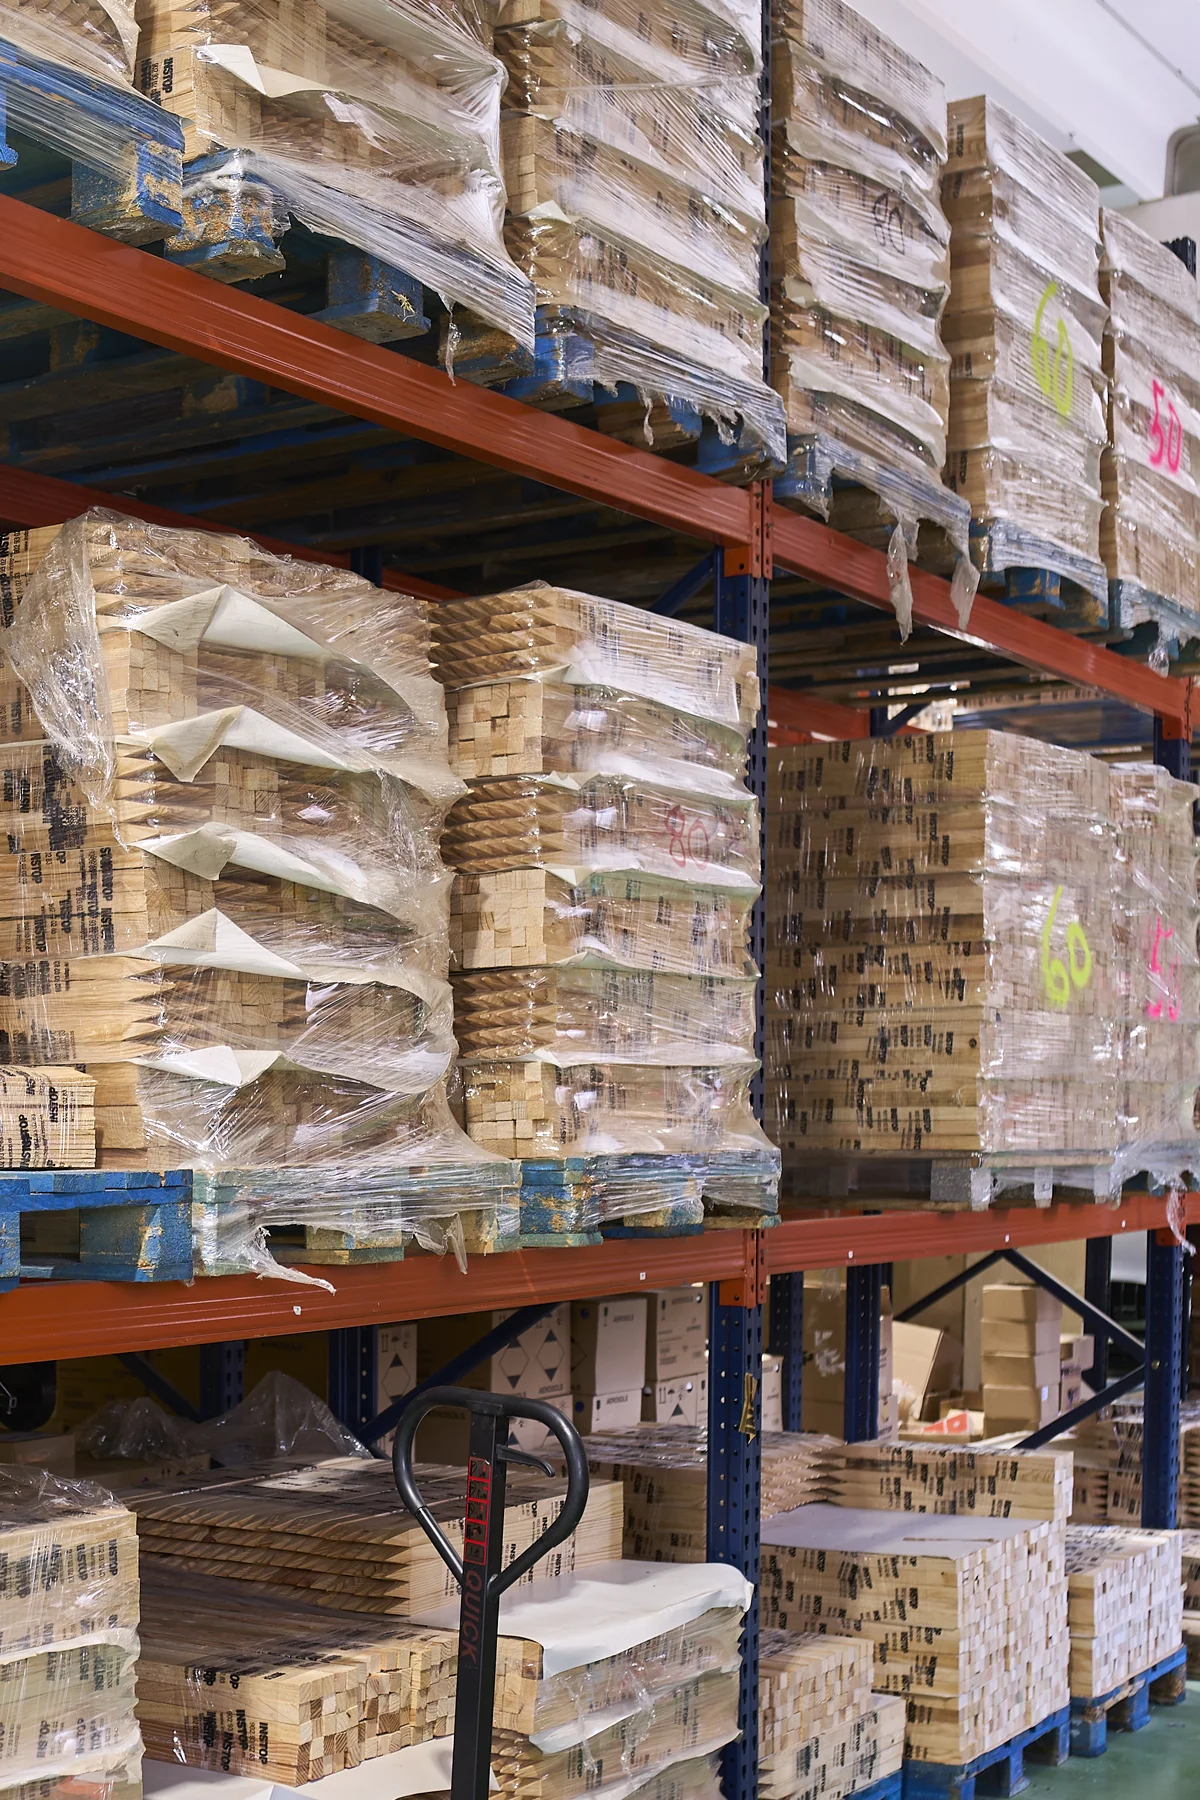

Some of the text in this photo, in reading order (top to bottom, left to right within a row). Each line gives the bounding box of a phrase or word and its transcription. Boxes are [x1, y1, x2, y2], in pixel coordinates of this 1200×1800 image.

[871, 192, 905, 255] 80
[1030, 281, 1073, 423] 60
[1150, 379, 1182, 474] 50
[926, 734, 934, 764] INSTOP
[946, 751, 954, 781] INSTOP
[664, 804, 710, 872] 80
[941, 835, 950, 866] INSTOP
[927, 880, 935, 909] INSTOP
[34, 919, 46, 952] INSTOP
[941, 907, 950, 941] INSTOP
[1042, 884, 1092, 1005] 60
[945, 1032, 954, 1055] INSTOP
[49, 1086, 58, 1123] INSTOP
[890, 1108, 899, 1132] INSTOP
[923, 1109, 931, 1134] INSTOP
[613, 1314, 634, 1322] AEROSOLS
[538, 1384, 564, 1394] AEROSOLS
[606, 1395, 629, 1404] AEROSOLS
[108, 1538, 118, 1576] INSTOP
[460, 1570, 483, 1663] QUICK
[236, 1710, 248, 1752] INSTOP
[258, 1722, 268, 1764] INSTOP
[220, 1731, 234, 1771] INSTOP
